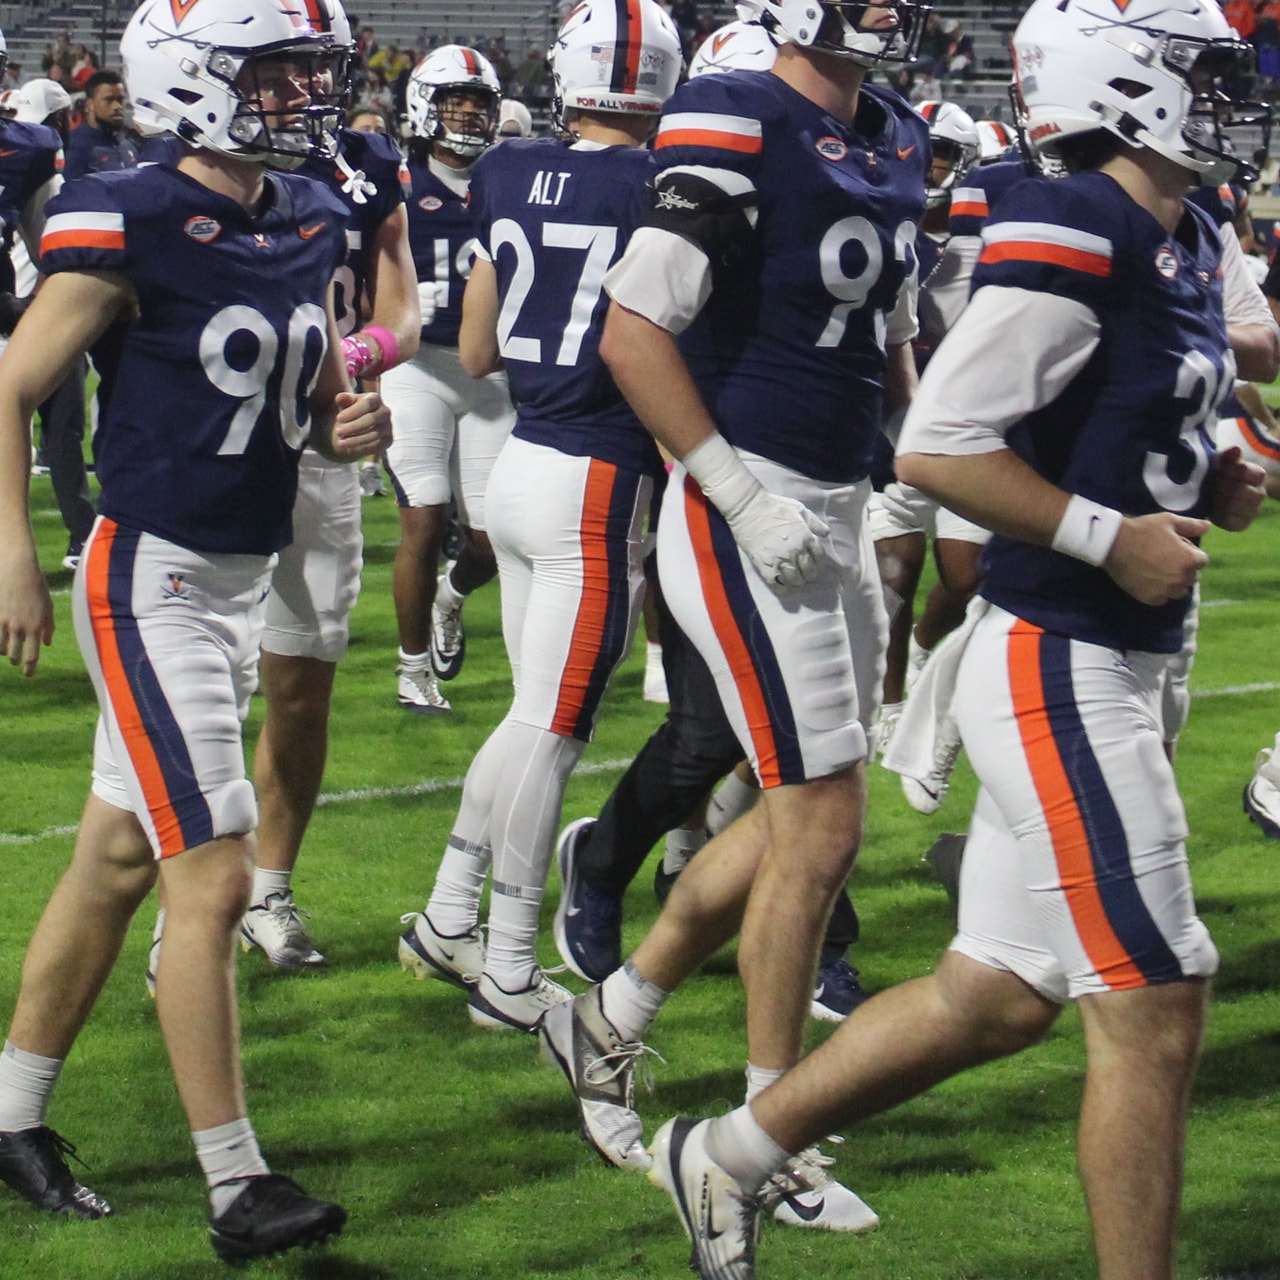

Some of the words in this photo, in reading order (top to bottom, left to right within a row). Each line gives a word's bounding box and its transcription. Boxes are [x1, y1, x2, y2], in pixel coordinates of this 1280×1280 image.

[576, 97, 596, 108] FOR
[599, 99, 619, 110] ALL
[527, 171, 571, 207] ALT
[489, 218, 619, 367] 27
[198, 303, 328, 455] 90
